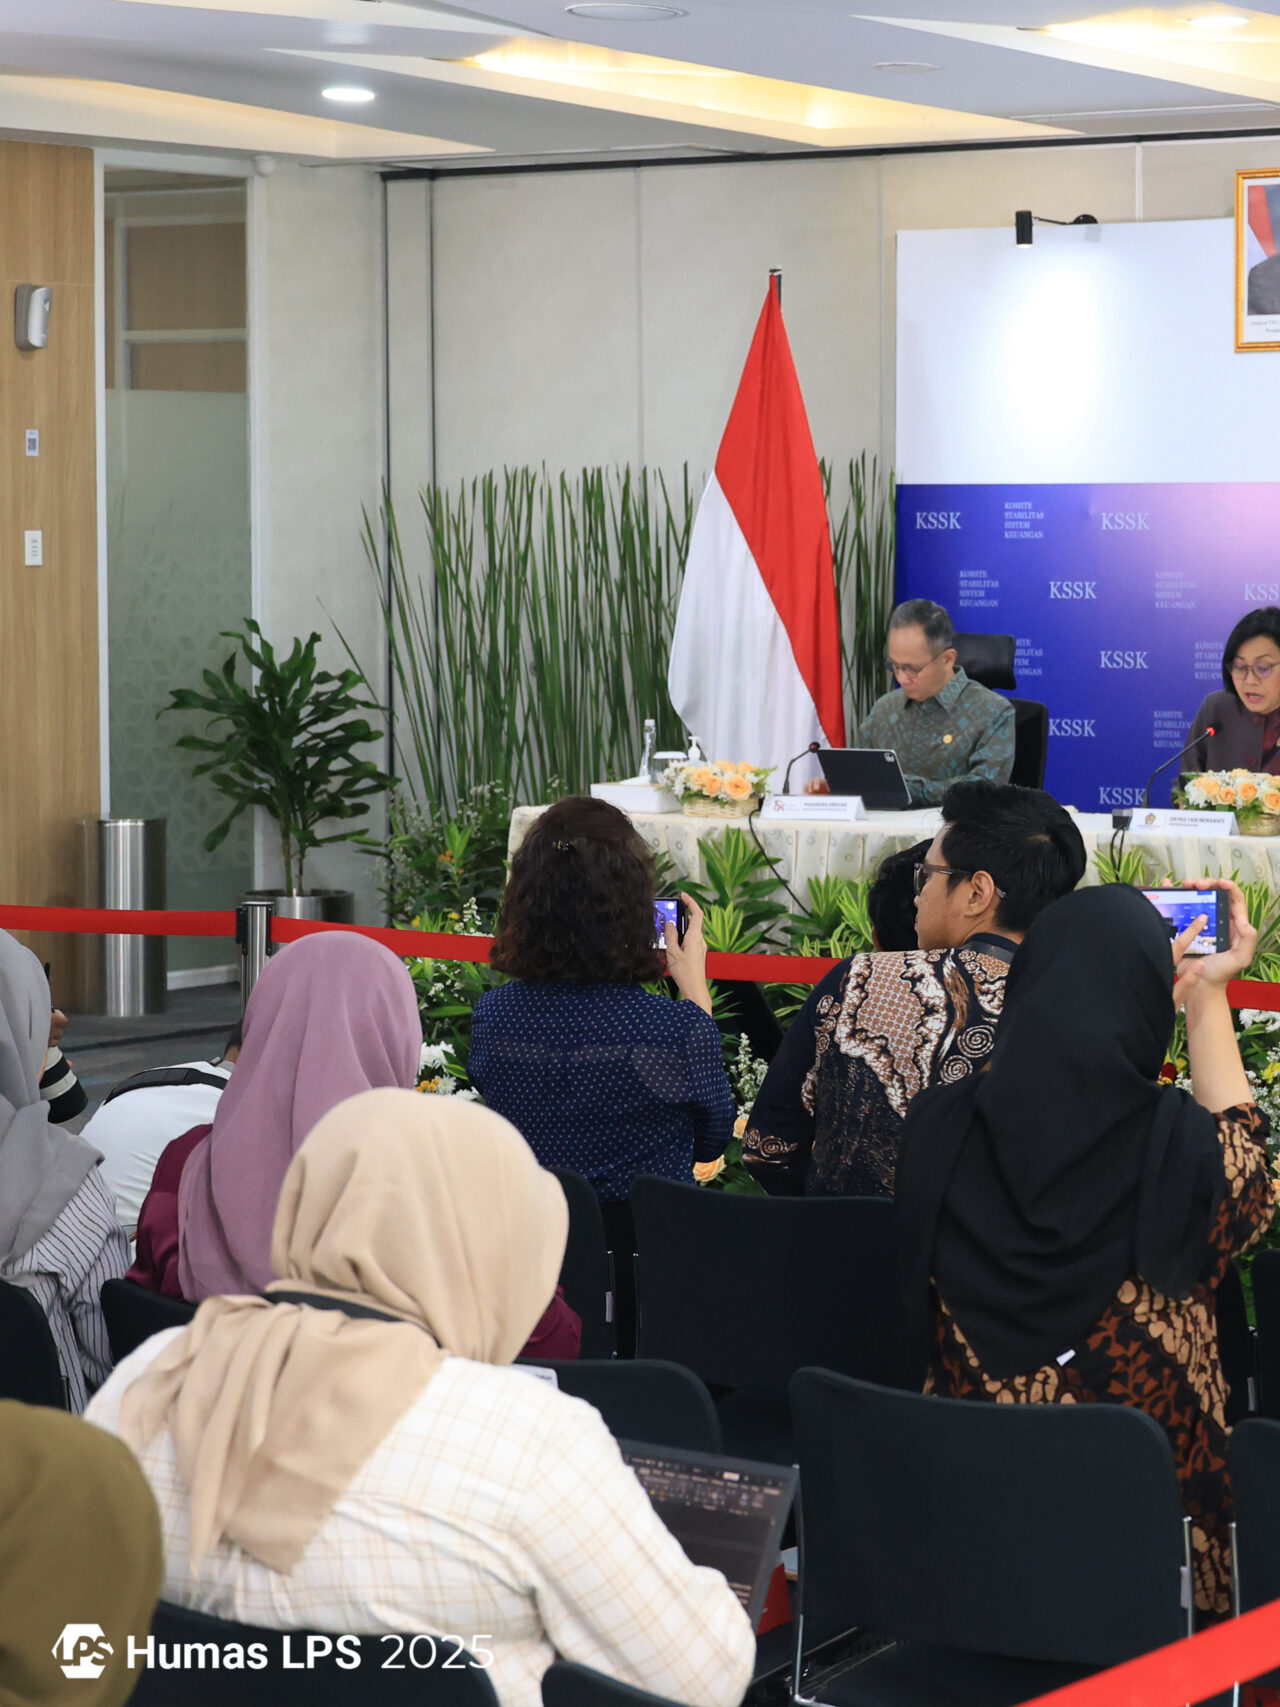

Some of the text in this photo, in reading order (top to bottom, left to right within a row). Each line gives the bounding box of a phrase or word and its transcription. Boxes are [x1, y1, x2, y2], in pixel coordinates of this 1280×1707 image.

[913, 512, 963, 530] KSSK
[1100, 512, 1150, 530] KSSK
[1048, 581, 1098, 599] KSSK
[1099, 651, 1149, 669] KSSK
[1047, 718, 1097, 737] KSSK
[1098, 787, 1147, 805] KSSK
